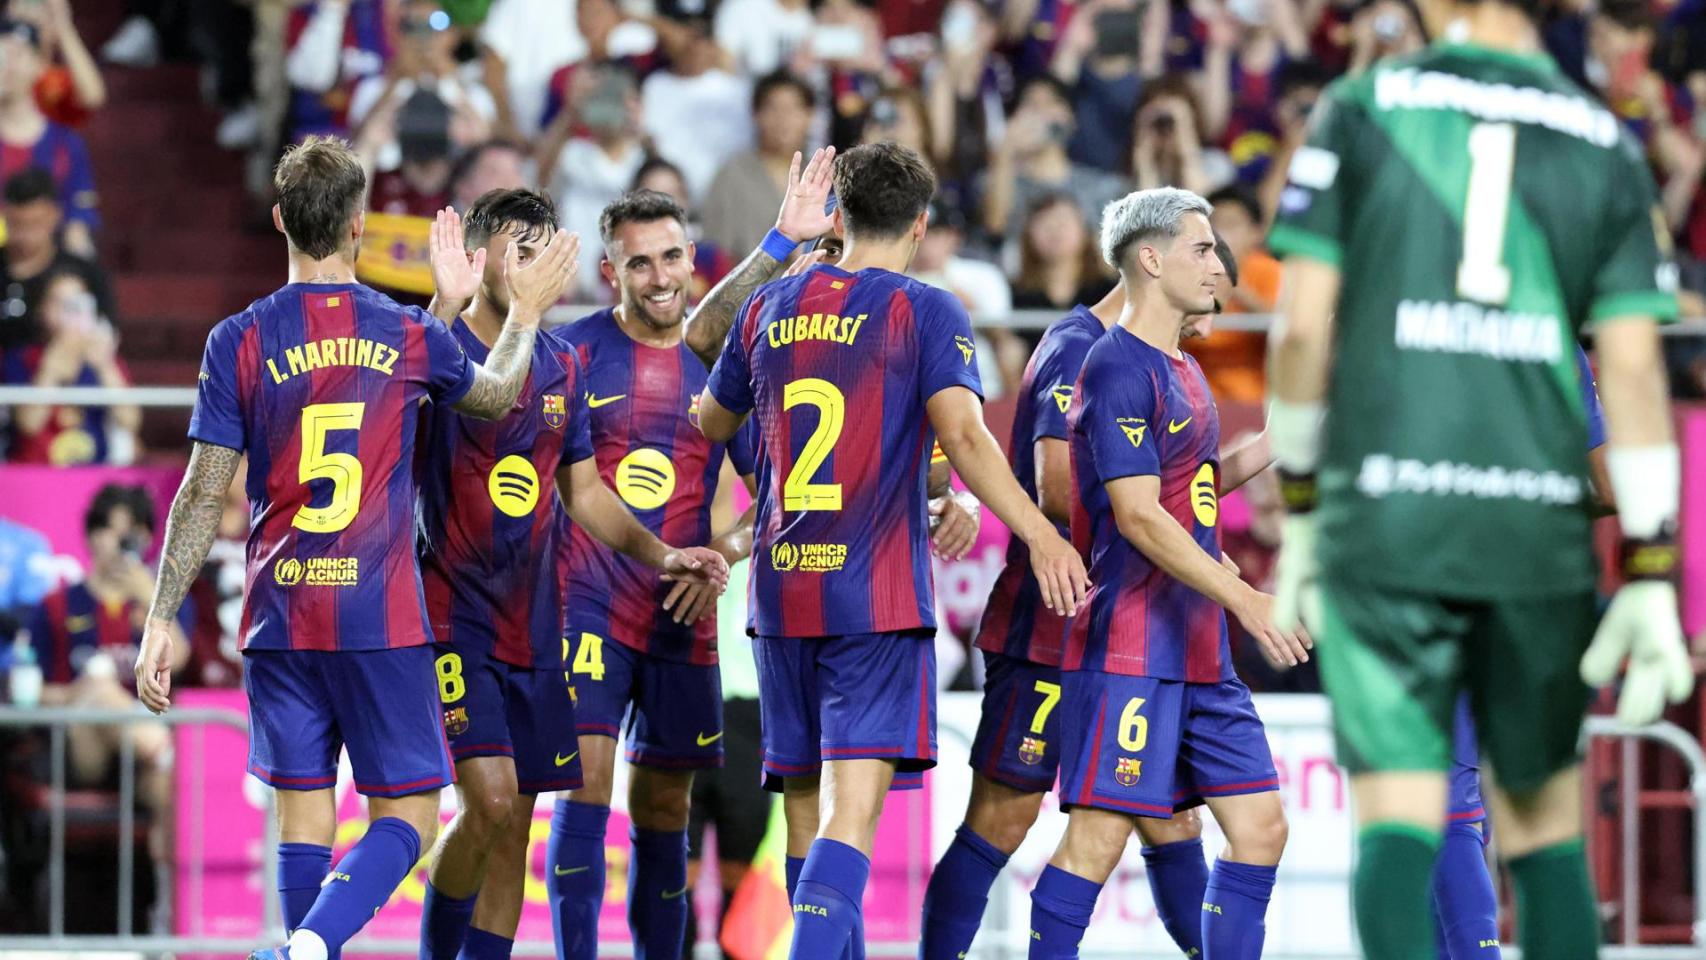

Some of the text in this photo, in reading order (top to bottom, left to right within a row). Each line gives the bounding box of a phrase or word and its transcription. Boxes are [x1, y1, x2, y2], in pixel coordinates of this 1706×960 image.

[1455, 121, 1517, 305] 1
[767, 313, 869, 349] CUBARSÍ
[266, 337, 400, 385] I. MARTINEZ
[291, 402, 366, 534] 5
[783, 377, 845, 512] 2
[306, 557, 359, 570] UNHCR
[799, 555, 846, 567] ACNUR
[801, 543, 848, 556] UNHCR
[305, 569, 358, 581] ACNUR
[434, 652, 466, 704] 8
[1030, 679, 1062, 735] 7
[1117, 697, 1149, 753] 6
